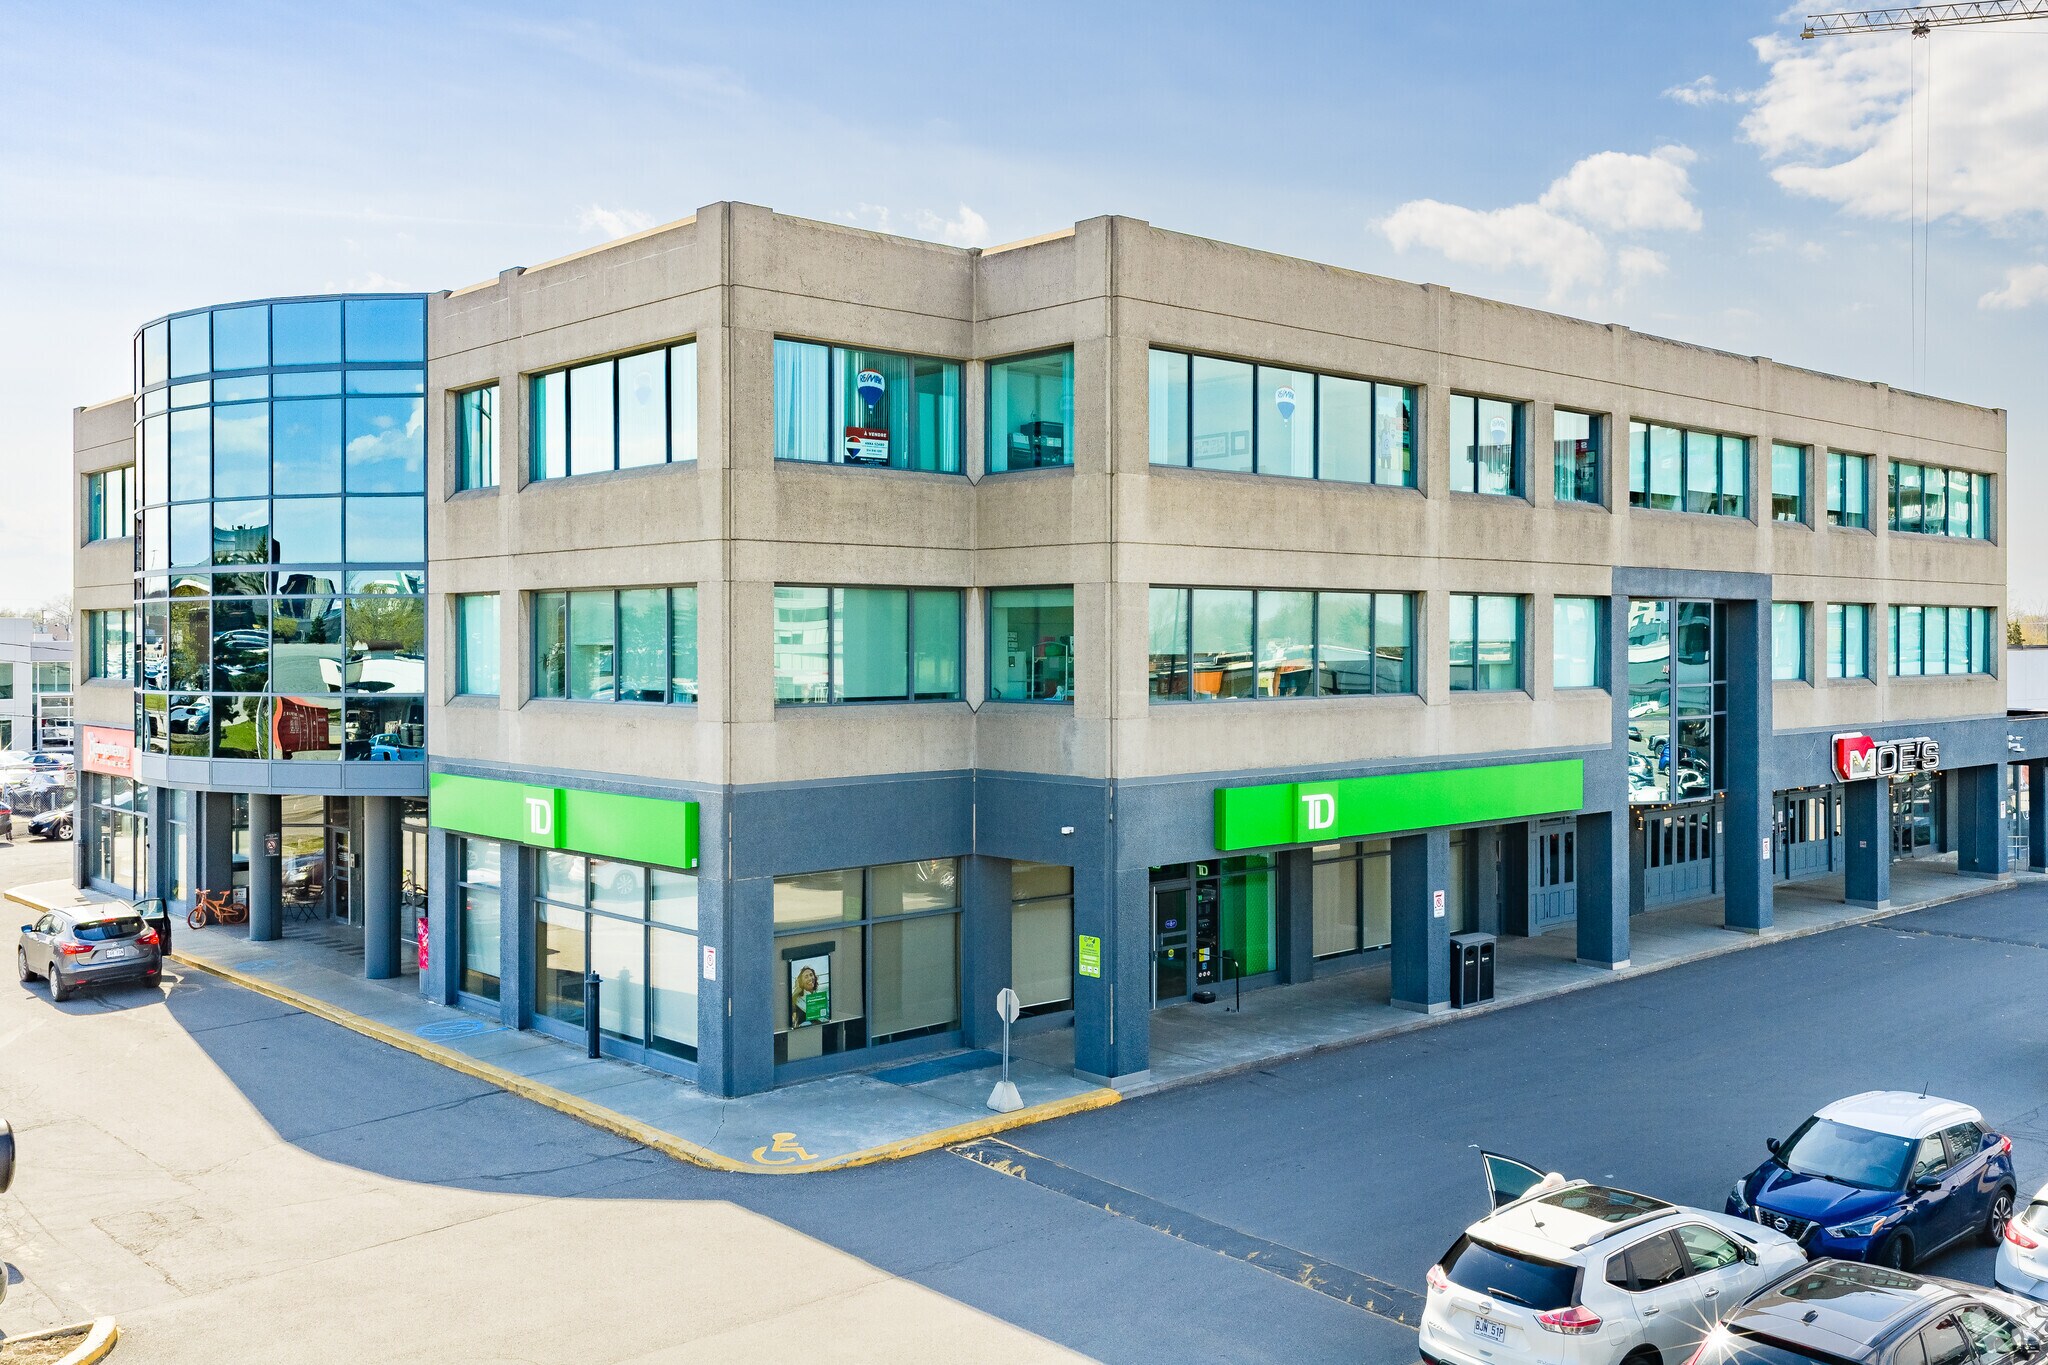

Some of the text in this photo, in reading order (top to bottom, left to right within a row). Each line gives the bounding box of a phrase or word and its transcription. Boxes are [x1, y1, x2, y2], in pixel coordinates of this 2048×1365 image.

[859, 373, 883, 385] RE/MAX
[1848, 740, 1940, 780] MOE'S
[526, 797, 551, 835] TD
[1301, 793, 1335, 830] TD
[1197, 864, 1209, 876] TD
[1475, 1320, 1489, 1333] BJN
[1491, 1325, 1504, 1337] 51P
